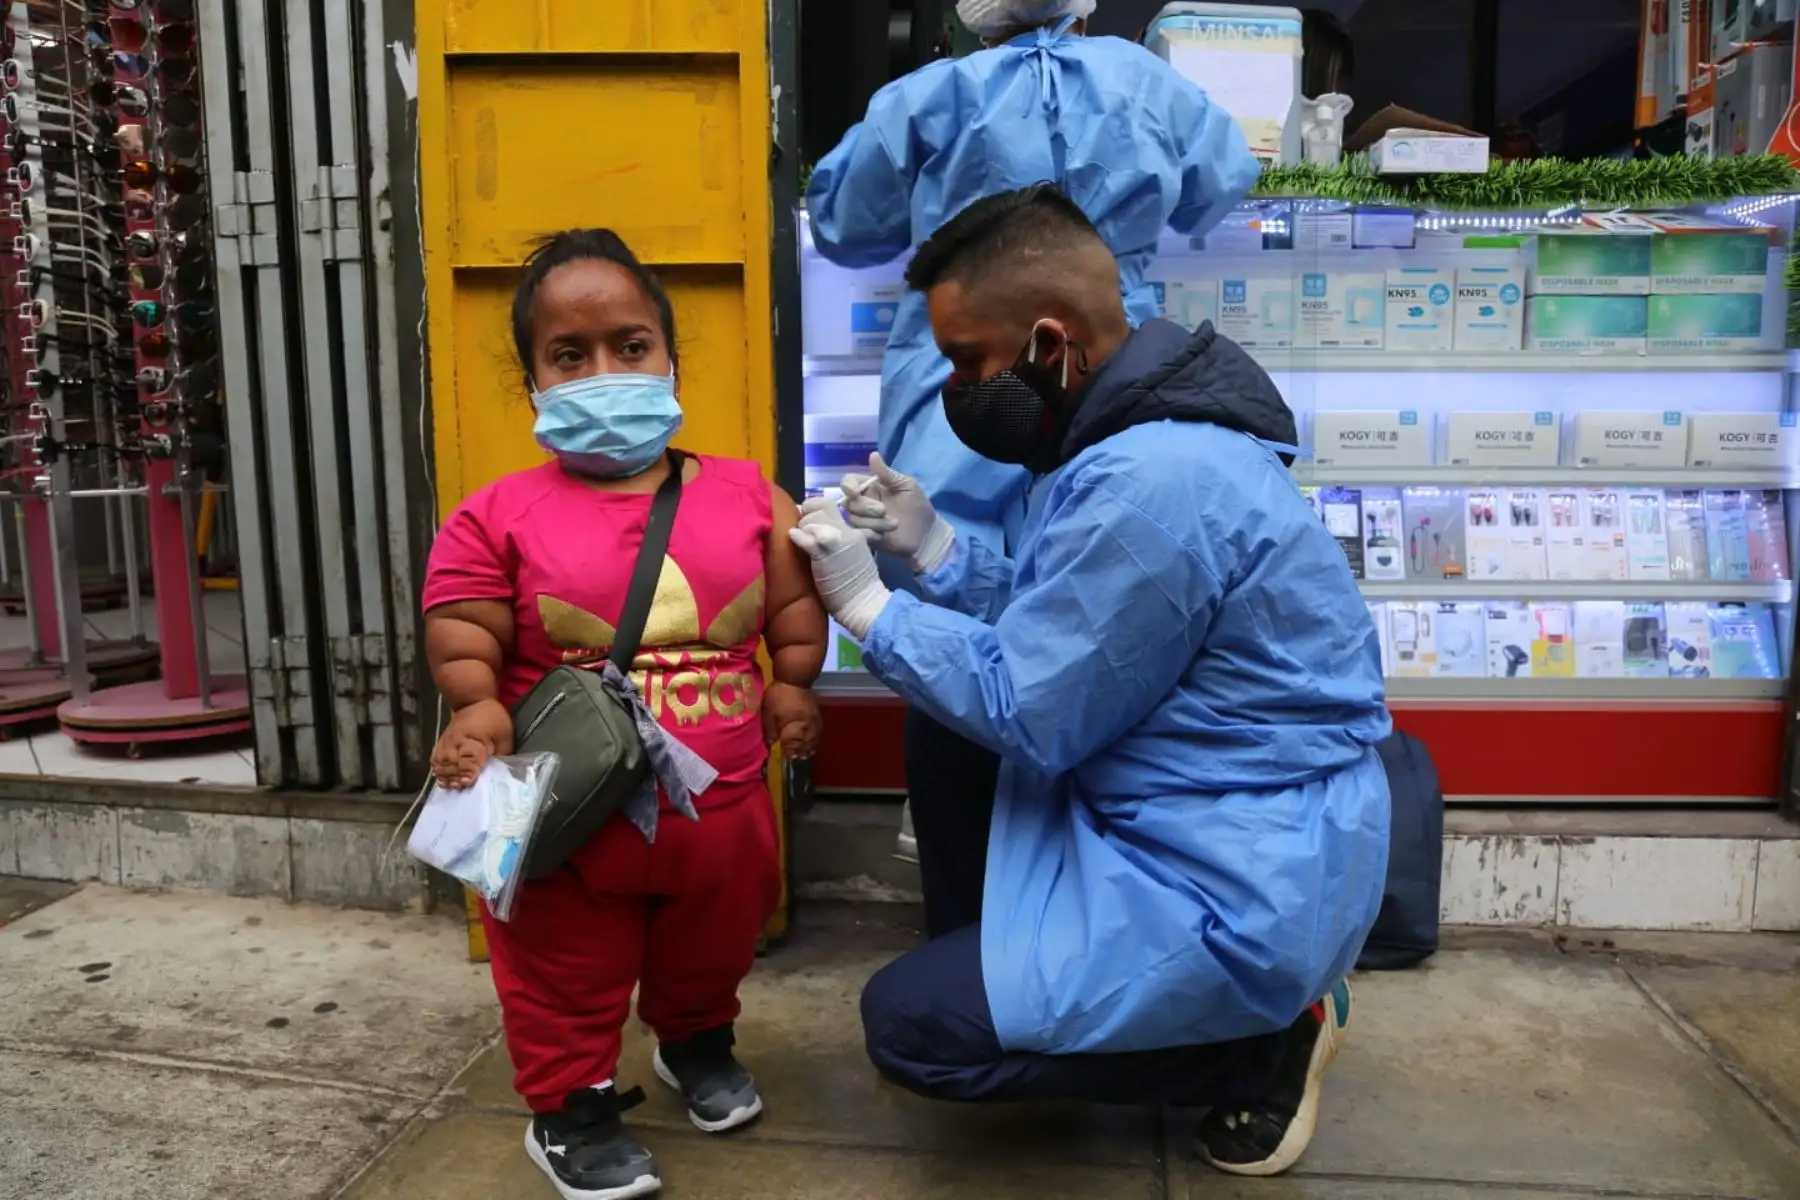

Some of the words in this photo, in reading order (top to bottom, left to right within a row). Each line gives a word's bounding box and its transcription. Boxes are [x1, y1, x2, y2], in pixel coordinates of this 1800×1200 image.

[1193, 20, 1277, 43] MINSA
[1388, 289, 1417, 298] KN95
[1458, 288, 1487, 297] KN95
[1221, 306, 1247, 314] KN95
[1301, 301, 1329, 310] KN95
[1339, 430, 1372, 441] KOGY
[1475, 430, 1507, 441] KOGY
[1604, 429, 1636, 441] KOGY
[1719, 431, 1751, 442] KOGY
